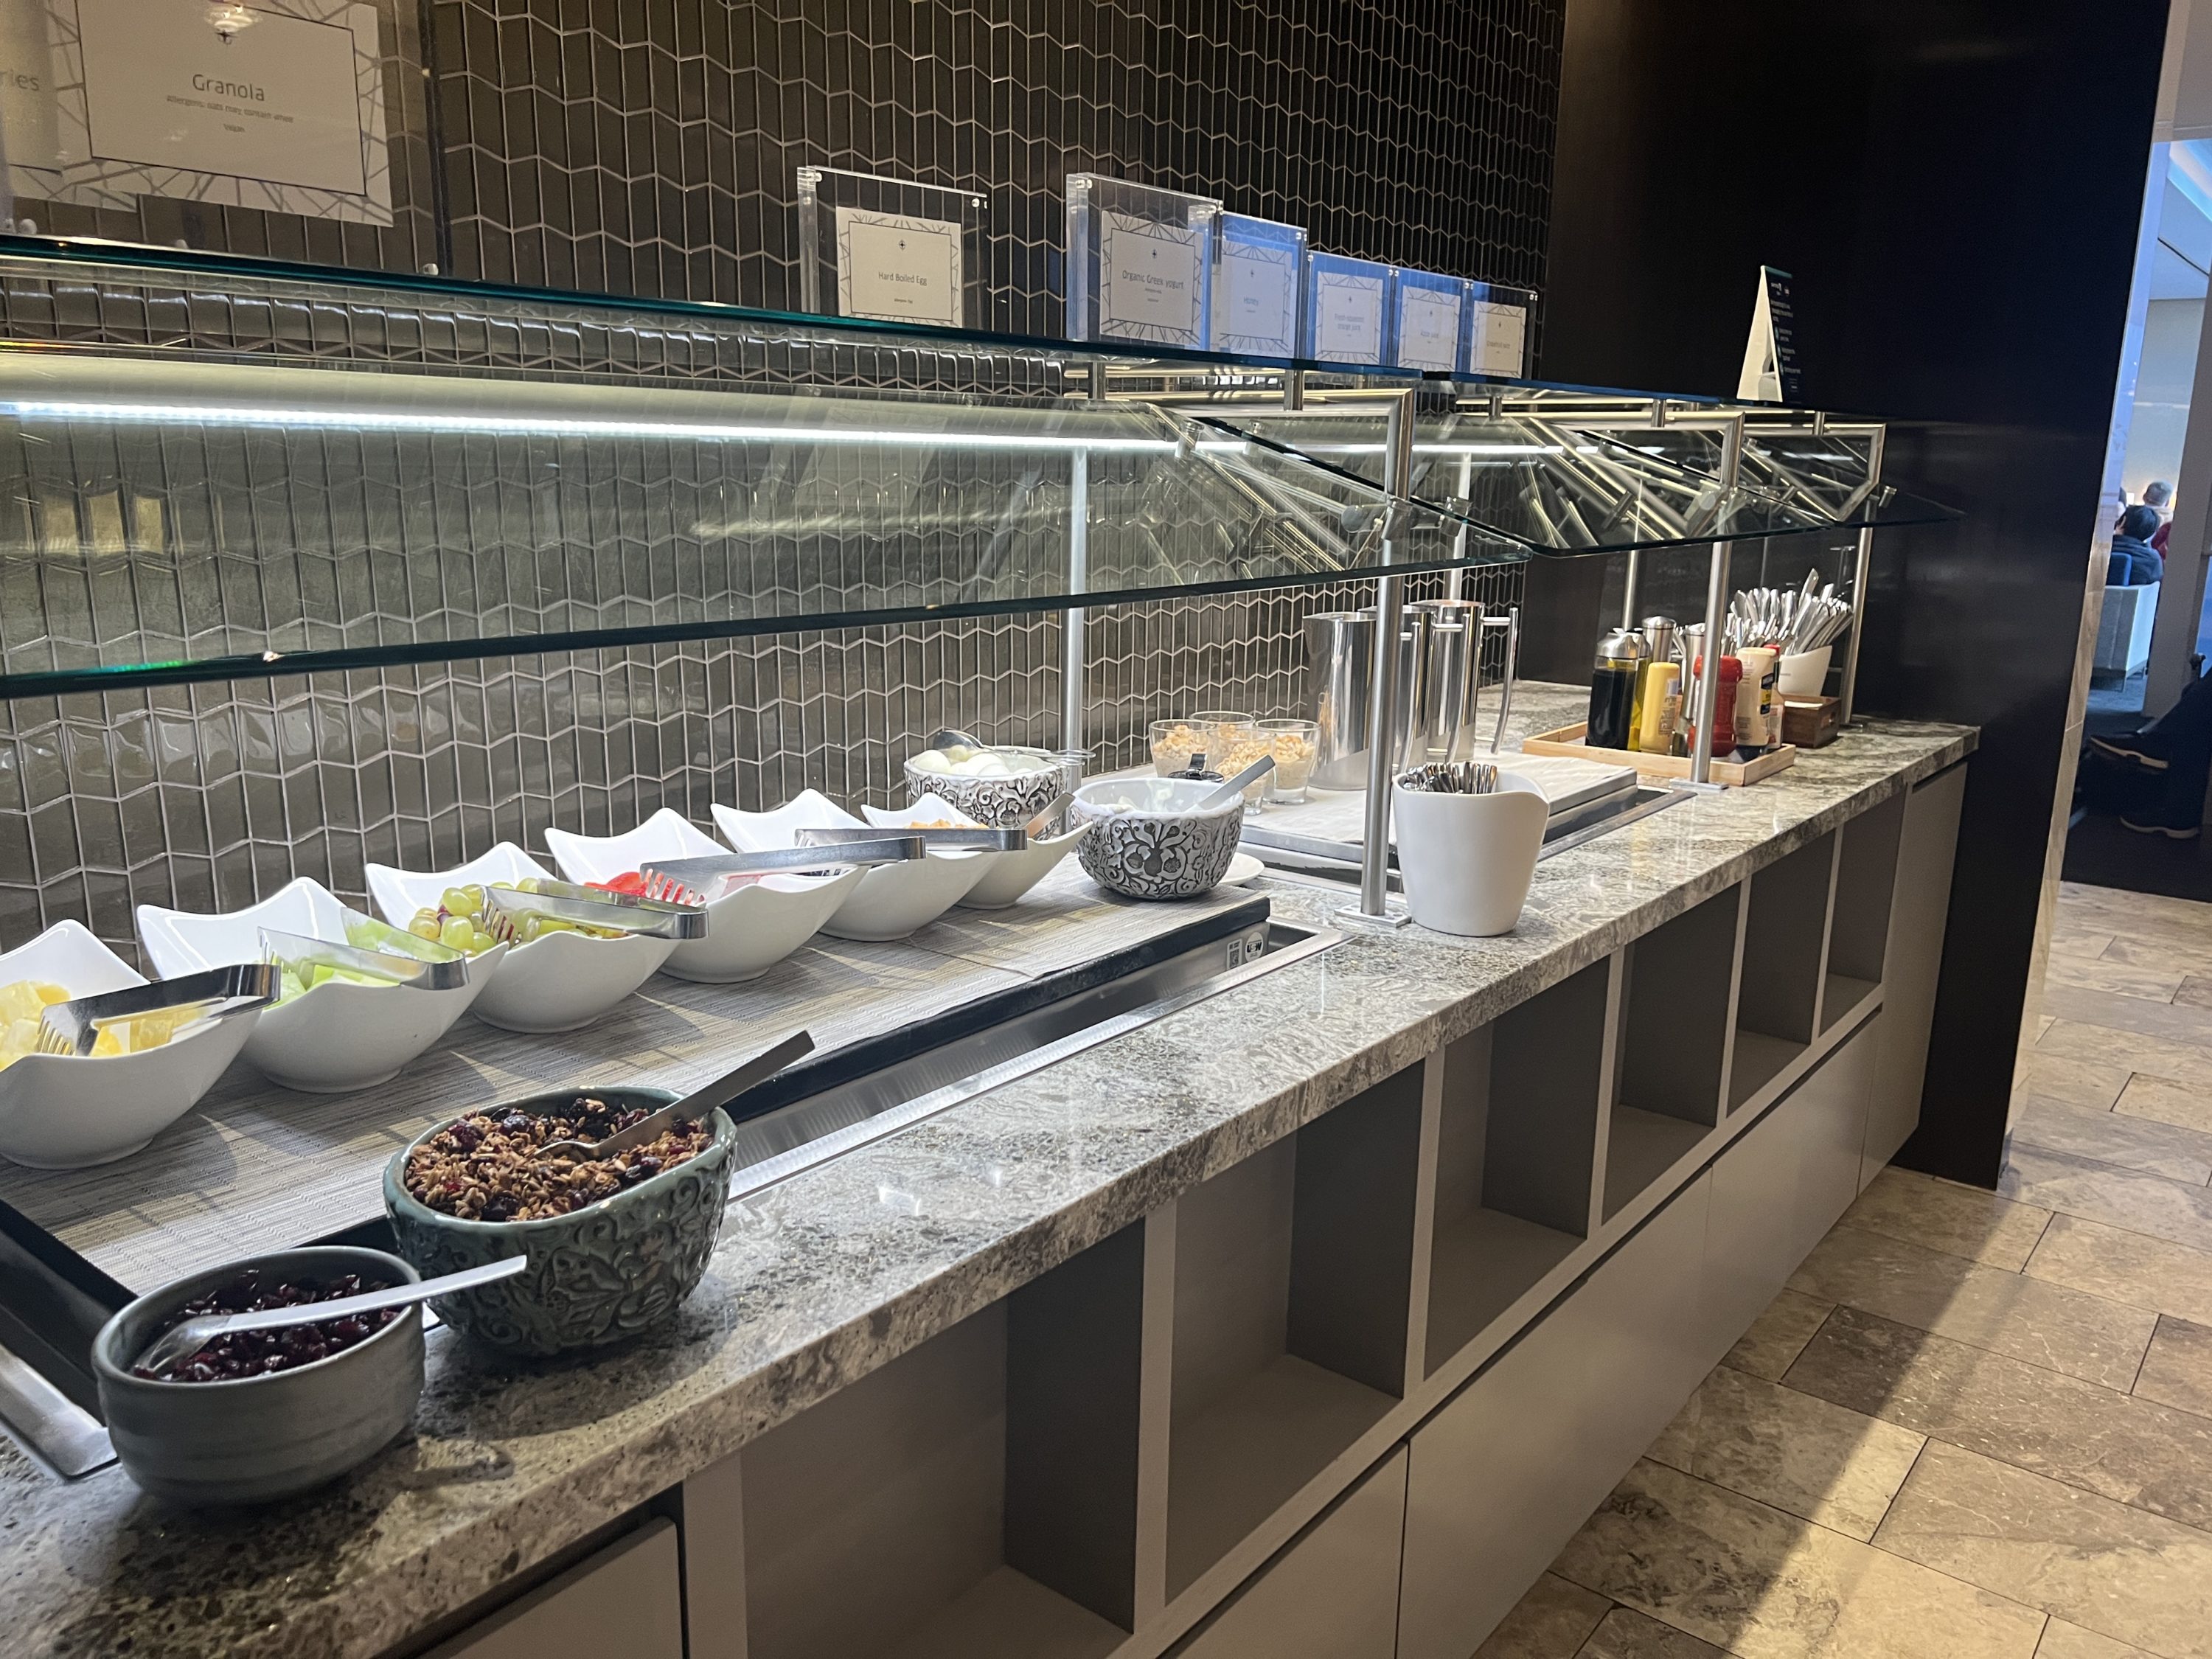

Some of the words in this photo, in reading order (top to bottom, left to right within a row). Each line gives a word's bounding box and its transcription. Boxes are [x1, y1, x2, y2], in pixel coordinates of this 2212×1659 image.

[192, 74, 265, 102] Granola
[878, 271, 894, 281] Hard
[895, 274, 914, 283] Boiled
[917, 275, 927, 286] Egg
[1122, 270, 1145, 282] Organic
[1147, 274, 1164, 285] Greek
